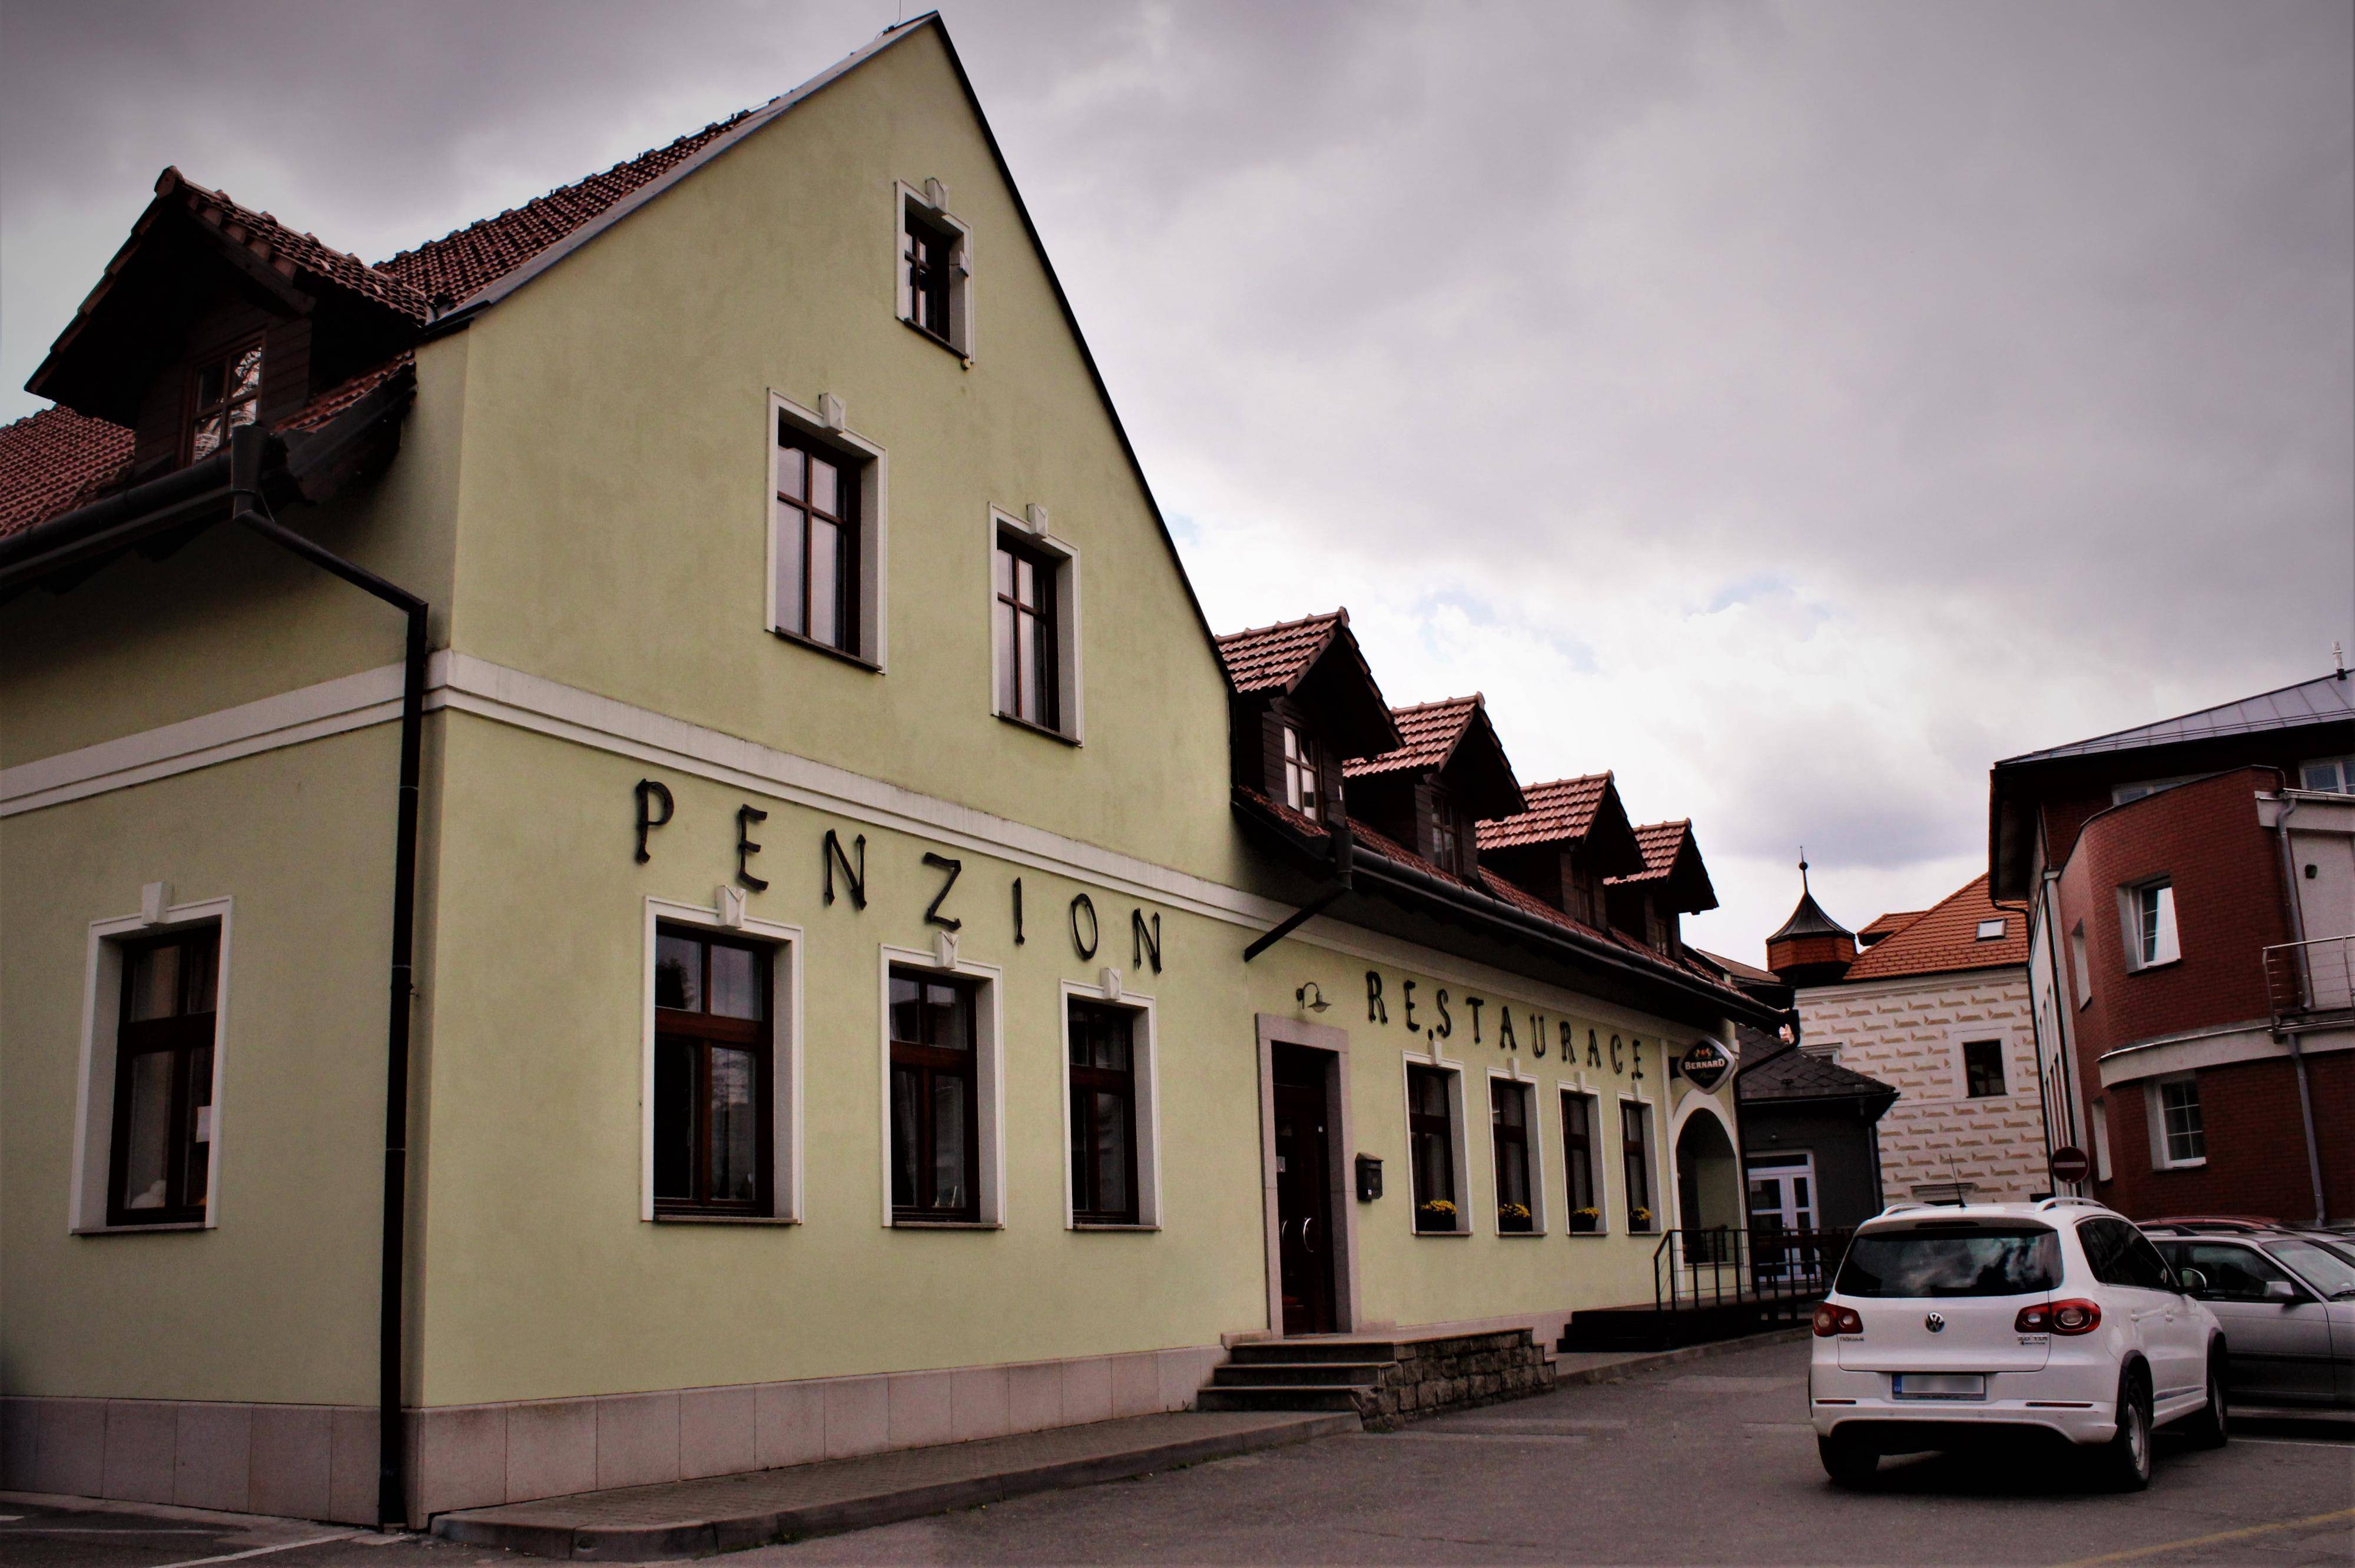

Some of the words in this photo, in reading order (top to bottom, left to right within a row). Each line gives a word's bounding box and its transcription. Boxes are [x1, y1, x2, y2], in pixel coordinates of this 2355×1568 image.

[635, 778, 1162, 974] PENZION
[1365, 971, 1643, 1078] RESTAURACE
[1684, 1058, 1725, 1070] BERNARD
